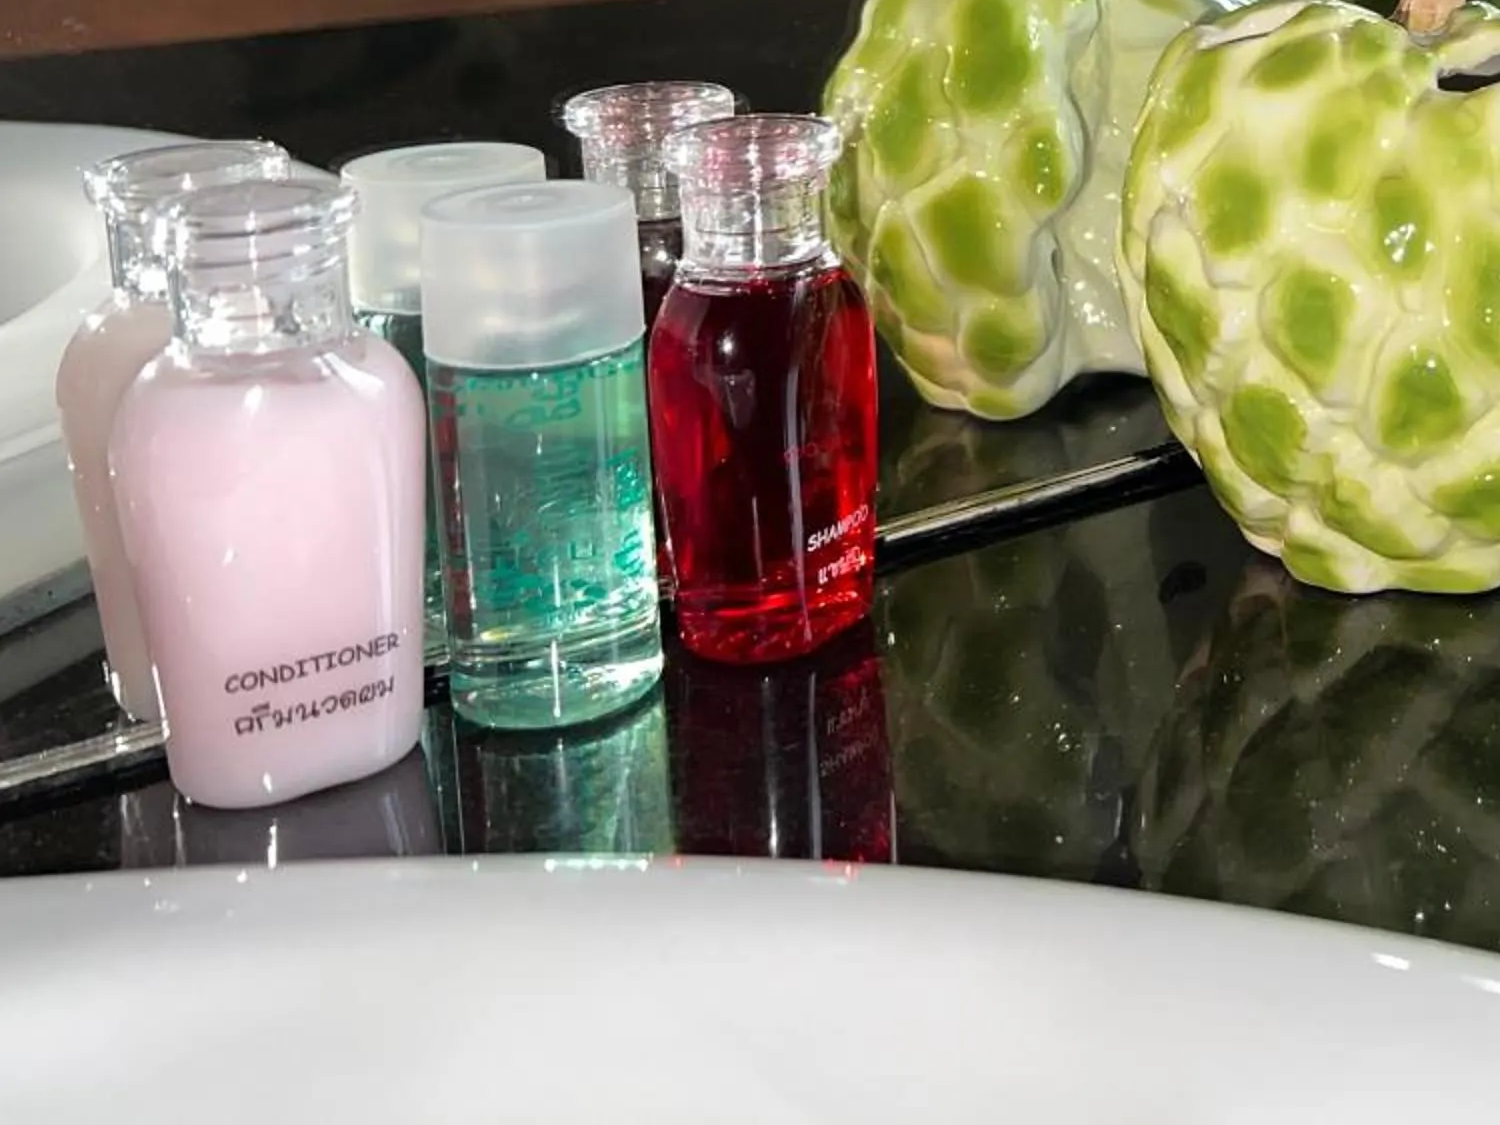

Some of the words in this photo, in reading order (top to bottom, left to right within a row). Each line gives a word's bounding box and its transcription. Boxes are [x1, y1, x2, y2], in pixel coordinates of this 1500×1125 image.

[224, 632, 400, 694] CONDITIONER
[234, 674, 396, 736] ครีมนวดผม
